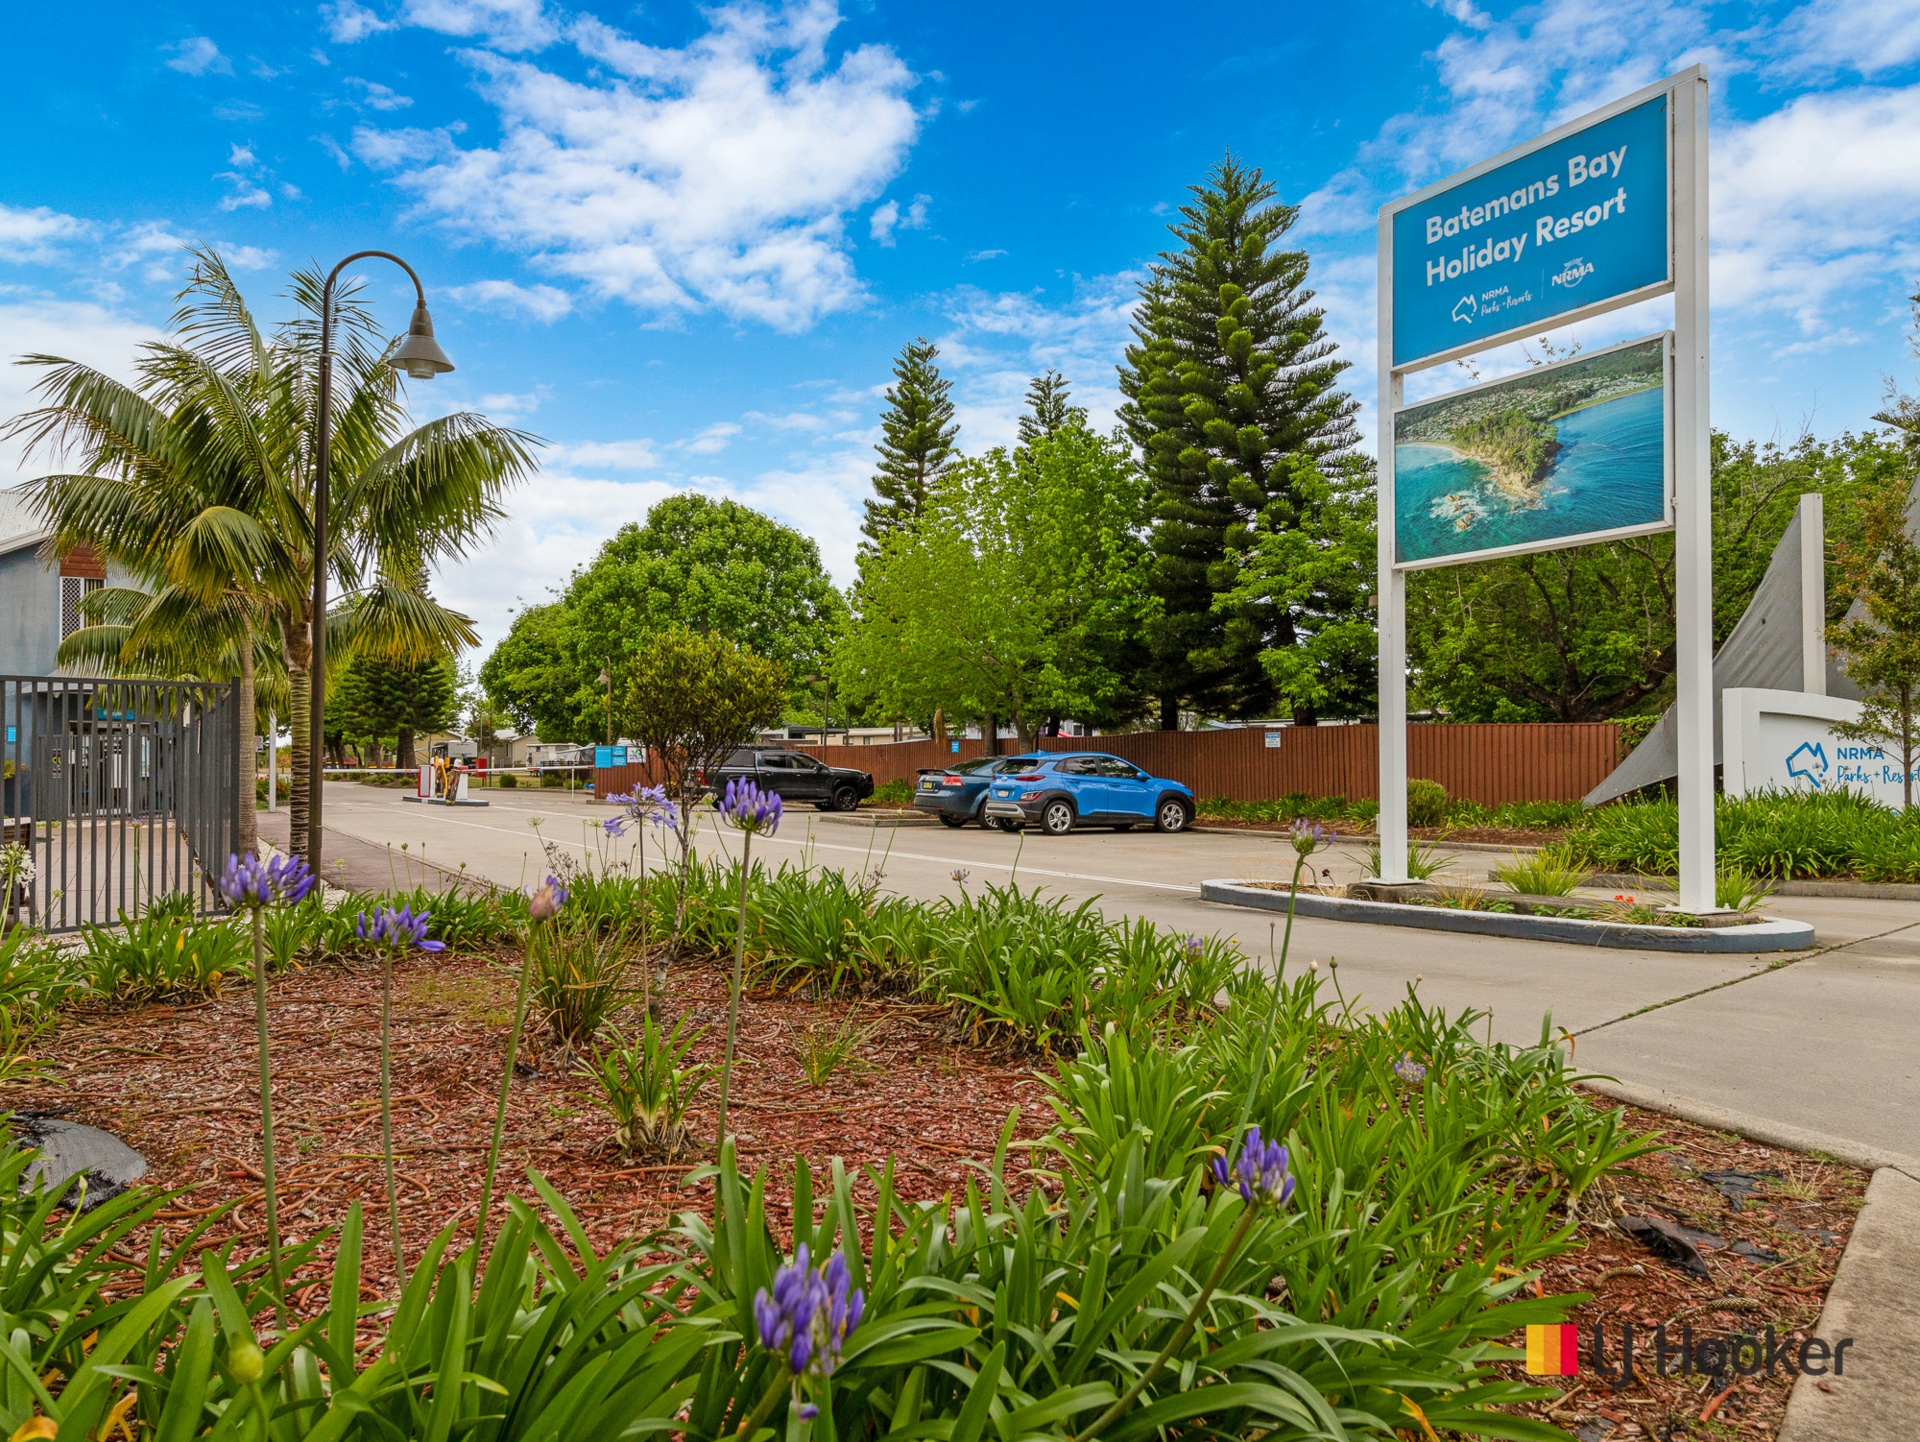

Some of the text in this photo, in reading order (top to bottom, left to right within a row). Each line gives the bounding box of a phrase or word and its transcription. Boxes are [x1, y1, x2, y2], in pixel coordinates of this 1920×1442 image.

[1425, 144, 1628, 245] Batemans Bay
[1426, 186, 1627, 287] Holiday Resort
[1551, 262, 1595, 287] NRMA
[1481, 285, 1509, 302] NRMA
[1481, 300, 1502, 317] Parks
[1506, 289, 1533, 309] Resorts
[1837, 747, 1885, 760] NRMA
[1837, 765, 1871, 784] Parks
